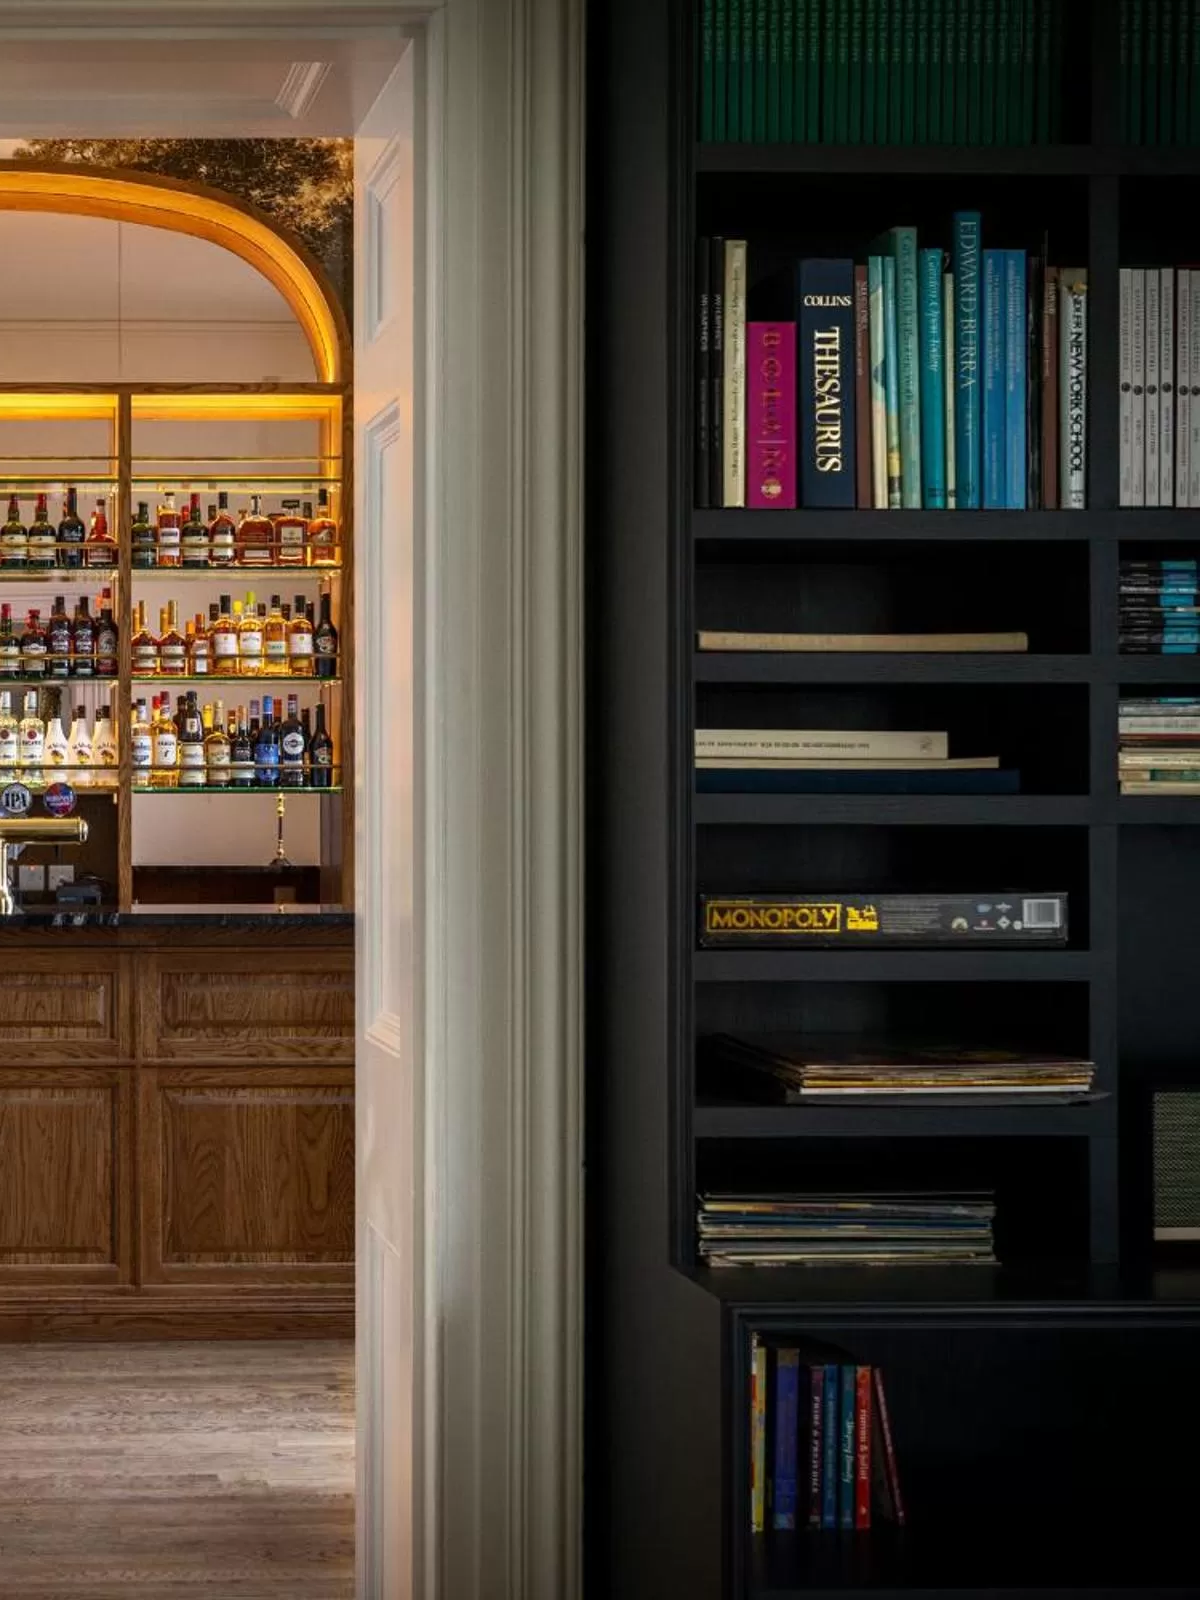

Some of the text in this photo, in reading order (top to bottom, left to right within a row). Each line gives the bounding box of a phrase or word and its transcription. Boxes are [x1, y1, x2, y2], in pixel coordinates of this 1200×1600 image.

[803, 294, 852, 308] COLLINS
[960, 221, 978, 390] EDWARD BURRA
[1069, 332, 1084, 372] NEW
[813, 326, 842, 473] THESAURUS
[1069, 372, 1084, 411] YORK
[1069, 413, 1084, 476] SCHOOL
[4, 792, 27, 808] IPA
[711, 907, 836, 929] MONOPOLY
[811, 1396, 821, 1426] PRIDE
[811, 1440, 821, 1493] PREJUDICE
